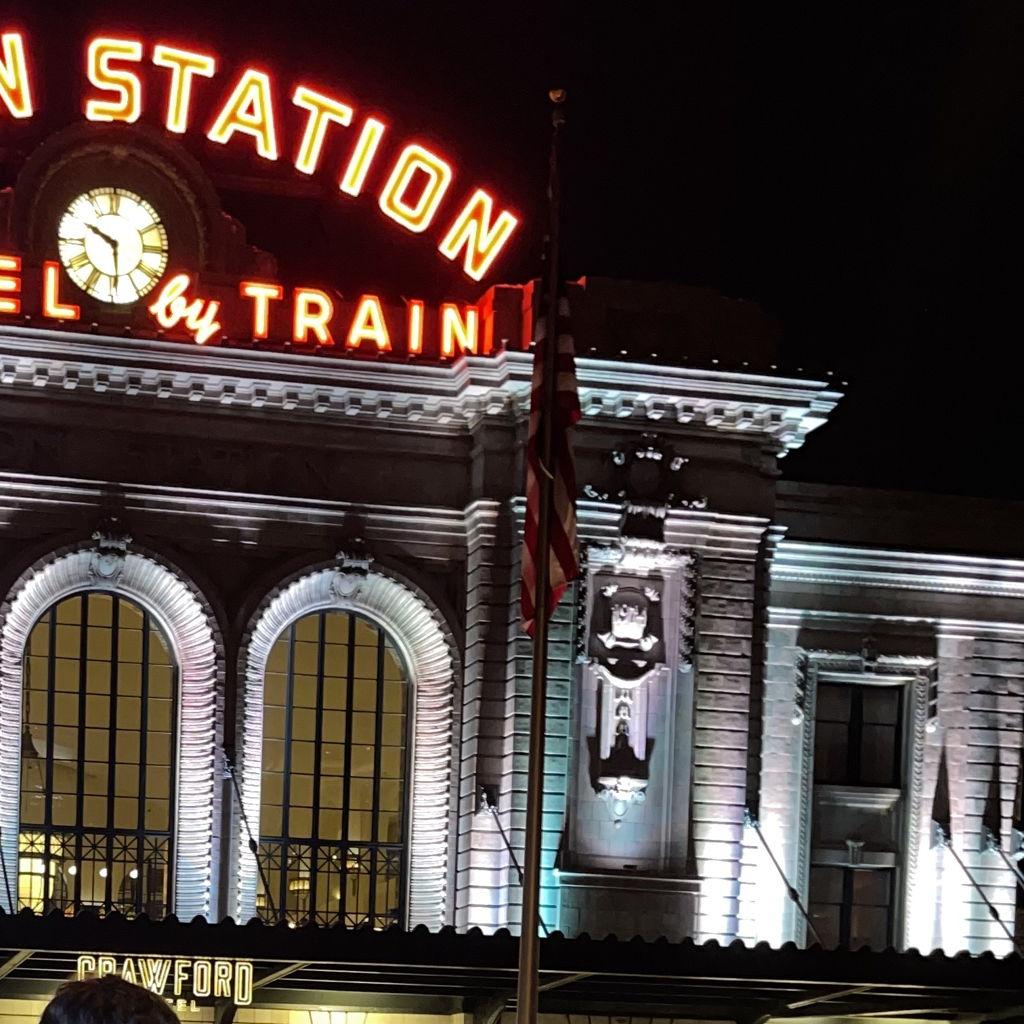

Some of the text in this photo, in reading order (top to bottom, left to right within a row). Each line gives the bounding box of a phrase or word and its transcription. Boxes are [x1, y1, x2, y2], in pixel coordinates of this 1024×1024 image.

[84, 34, 520, 282] STATION
[148, 272, 222, 345] by
[240, 281, 479, 357] TRAIN
